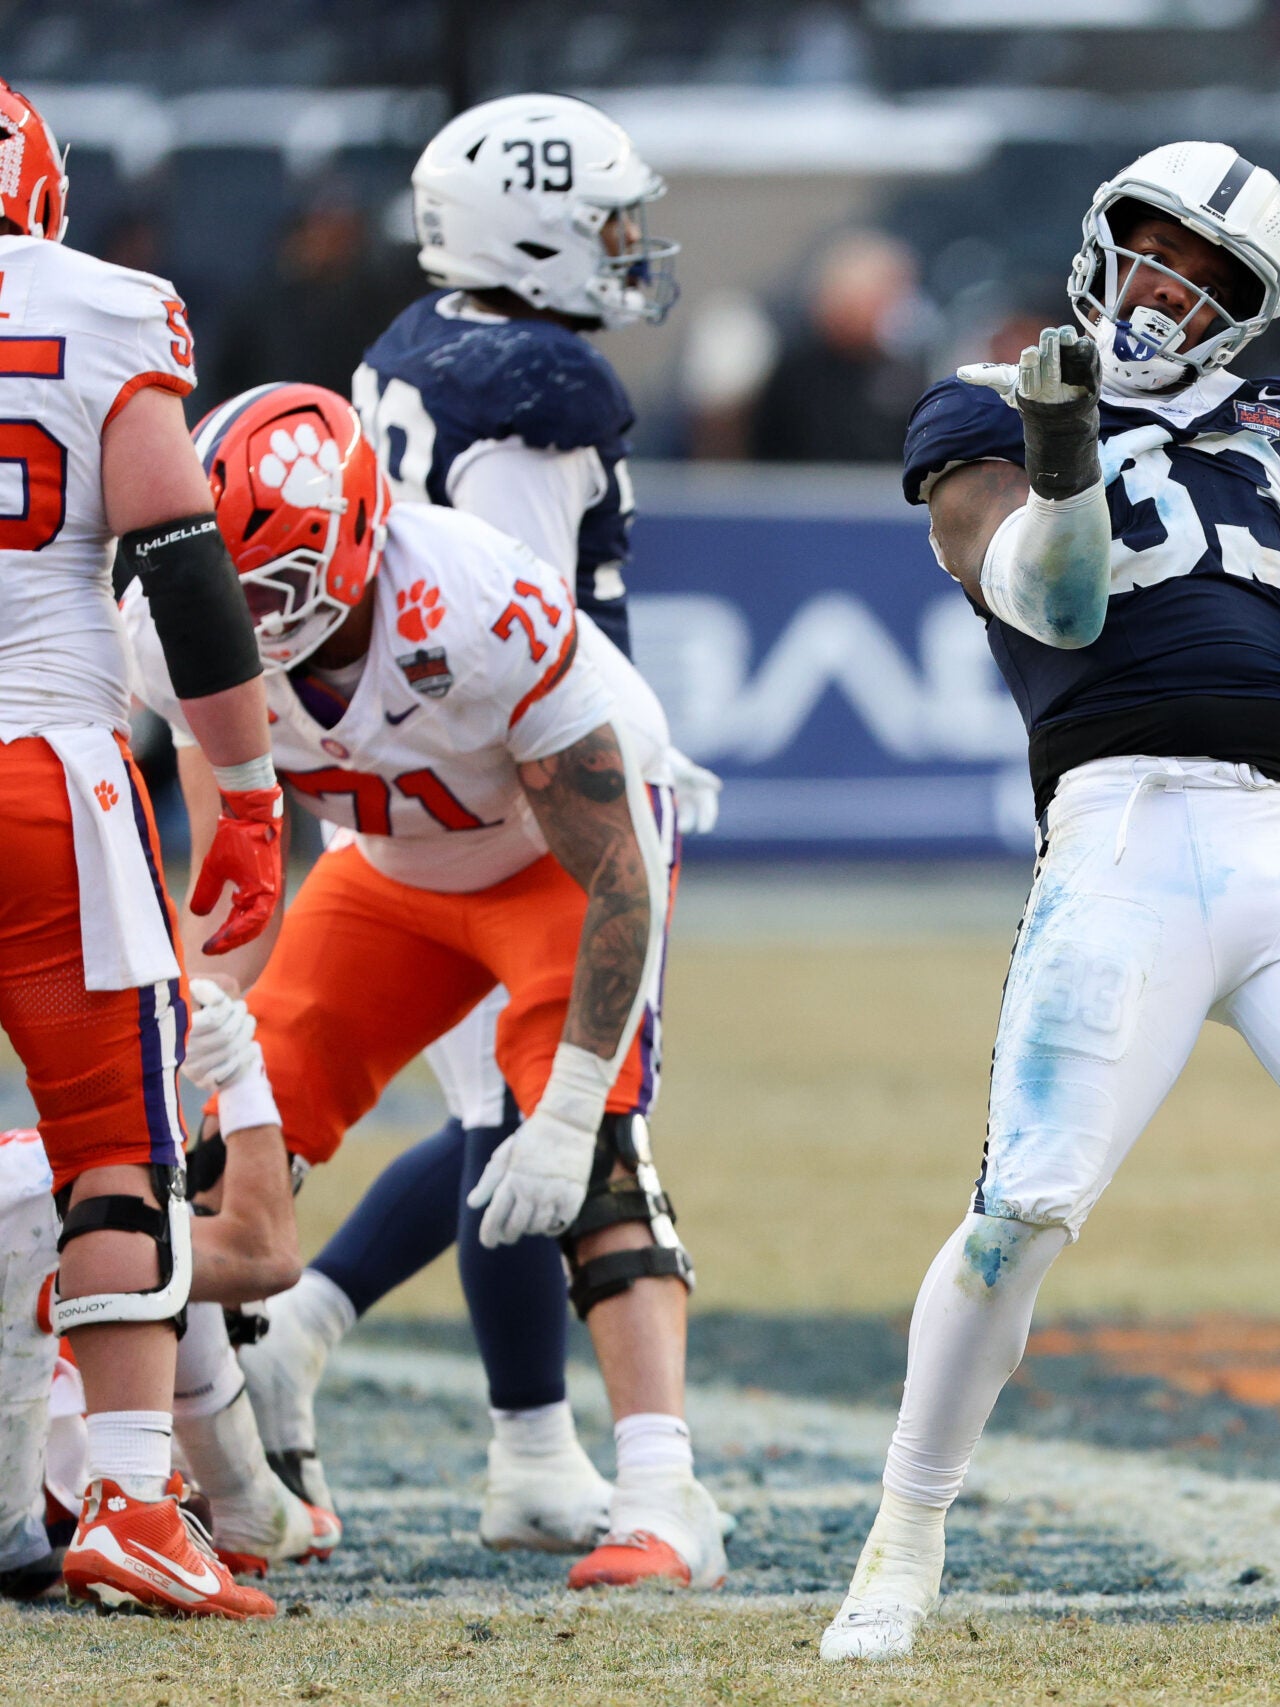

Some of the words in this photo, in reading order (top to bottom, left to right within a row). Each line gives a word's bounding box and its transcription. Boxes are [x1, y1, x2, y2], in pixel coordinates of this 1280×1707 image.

[503, 139, 573, 193] 39
[1151, 316, 1172, 332] SHOCK
[491, 578, 562, 664] 71
[275, 765, 505, 837] 71
[58, 1301, 108, 1320] DONJOY
[123, 1556, 173, 1591] FORCE
